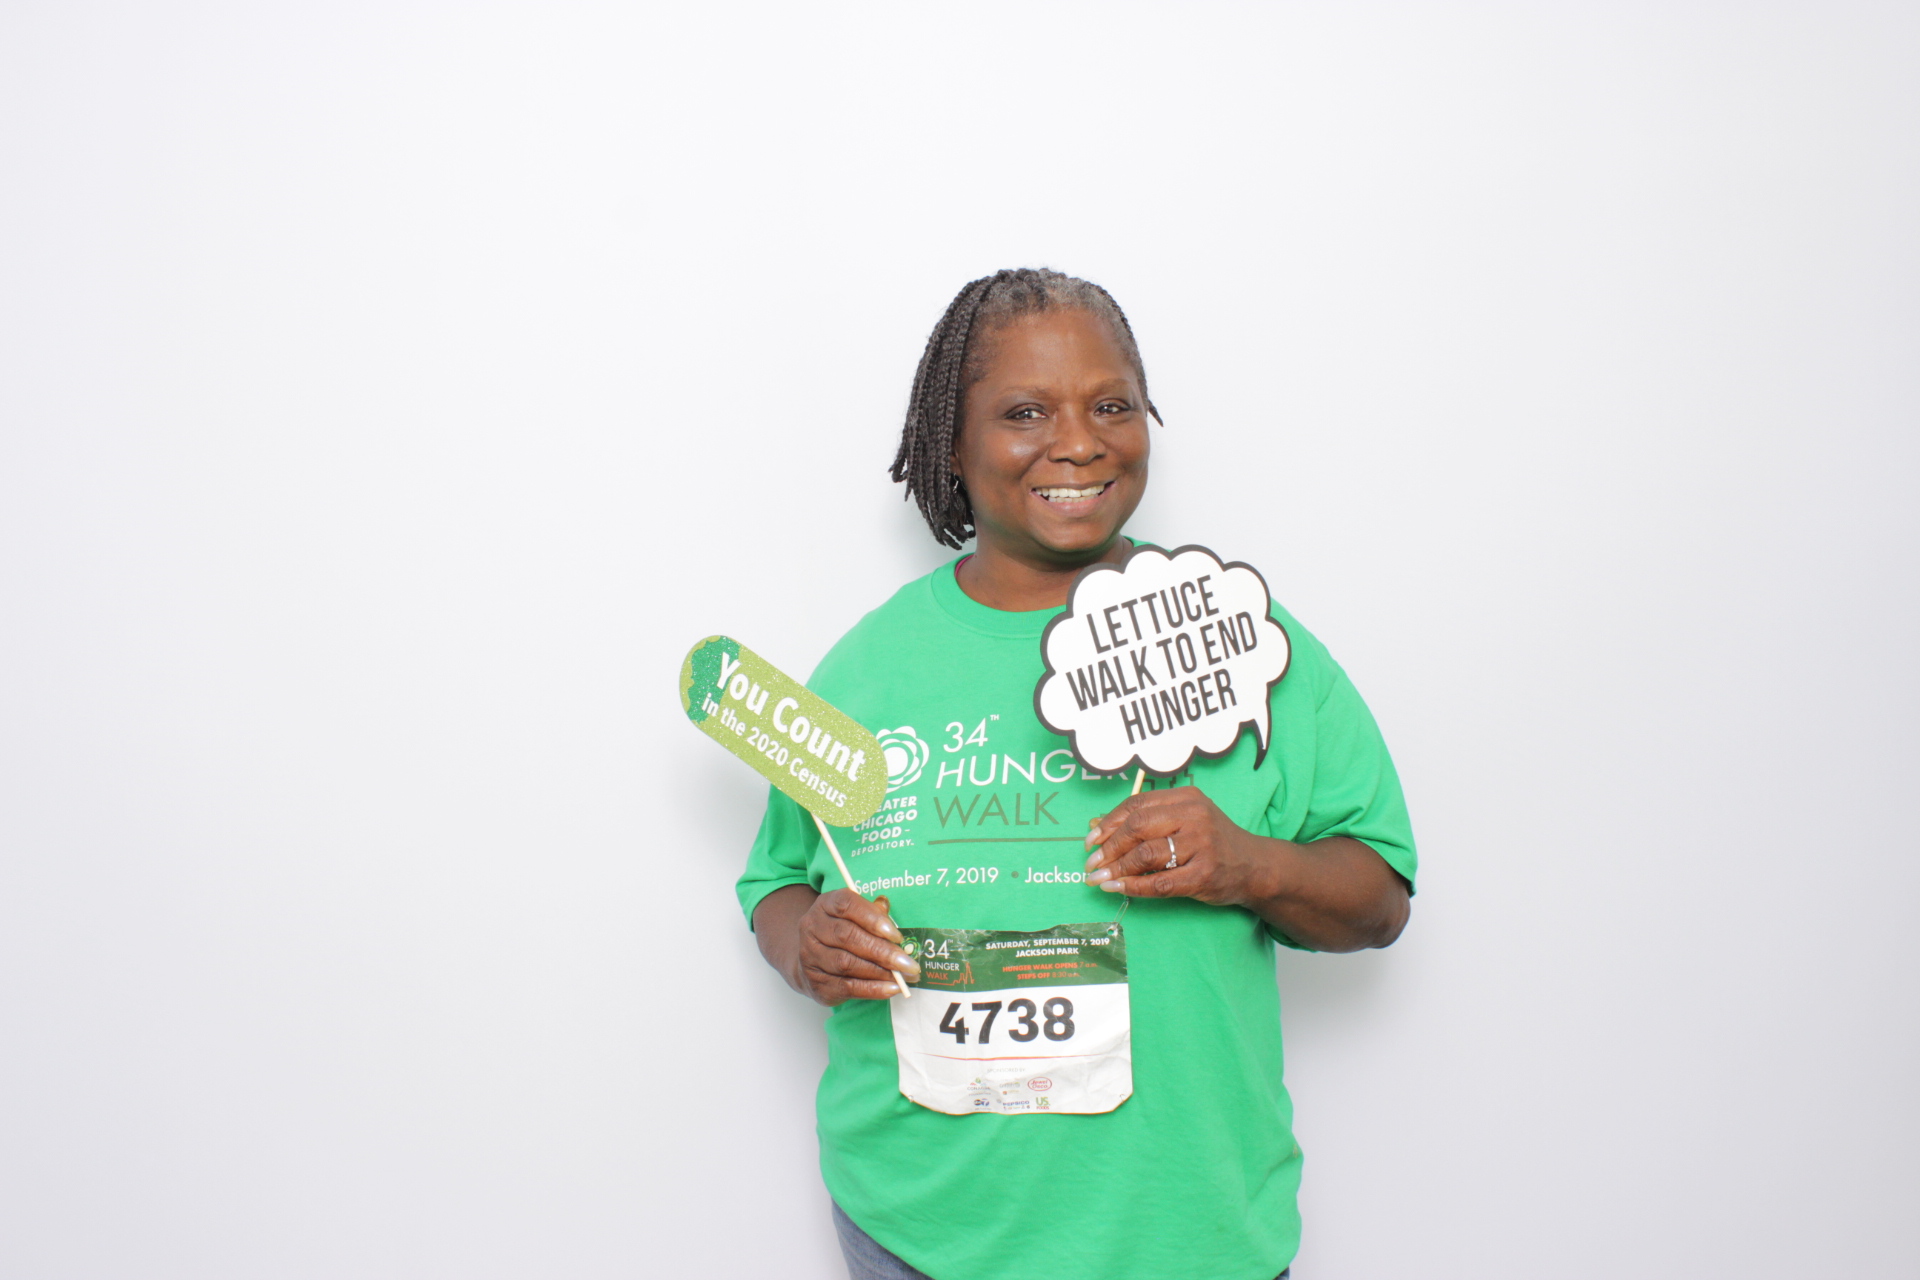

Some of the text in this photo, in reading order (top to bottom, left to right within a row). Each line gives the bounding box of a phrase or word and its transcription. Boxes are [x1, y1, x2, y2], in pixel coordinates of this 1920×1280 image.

[1086, 574, 1219, 654] LETTUCE
[1066, 611, 1258, 711] WALK TO END
[717, 651, 866, 782] You Count
[1119, 668, 1238, 745] HUNGER
[701, 692, 848, 808] in the 2020 Census
[852, 809, 918, 832] CHICAGO
[933, 791, 1060, 829] WALK
[854, 870, 931, 897] September
[936, 867, 950, 888] 7,
[956, 867, 999, 884] 2019
[985, 937, 1110, 950] SATURDAY, SEPTEMBER 7, 2019
[1015, 947, 1080, 958] JACKSON PARK
[924, 961, 960, 972] HUNGER
[926, 971, 949, 980] WALK
[1002, 964, 1032, 972] HUNGER
[939, 996, 1076, 1045] 4738
